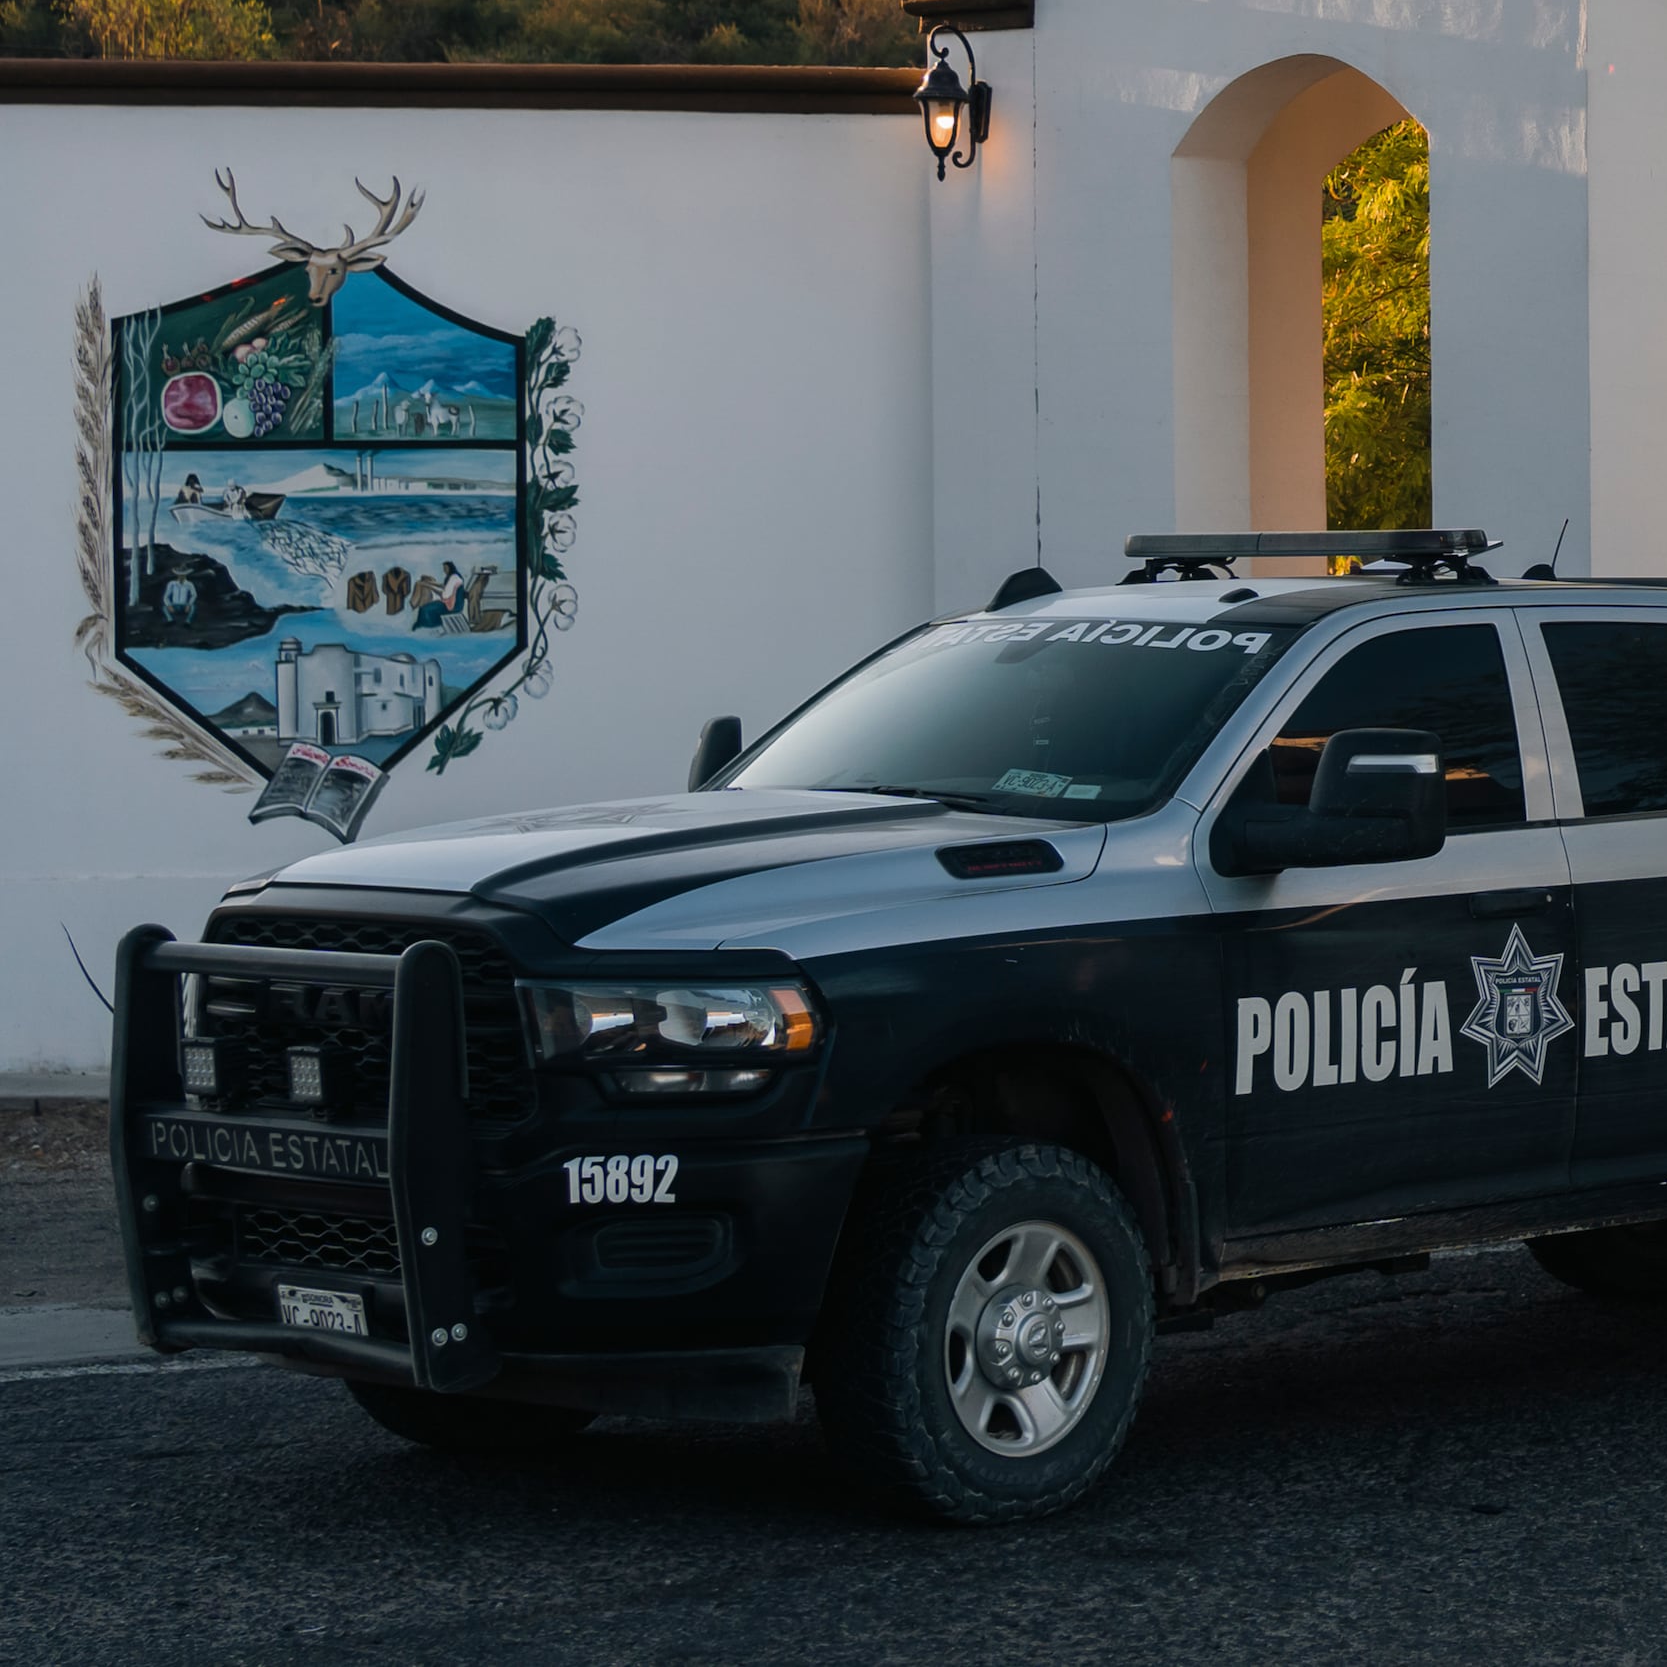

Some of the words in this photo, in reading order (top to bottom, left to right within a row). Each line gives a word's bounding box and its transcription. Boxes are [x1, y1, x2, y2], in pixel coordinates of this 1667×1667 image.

[268, 984, 395, 1027] RAM
[1235, 967, 1454, 1095] POLICÍA
[151, 1121, 260, 1165] POLICIA
[268, 1131, 390, 1179] ESTATAL
[563, 1154, 679, 1204] 15892
